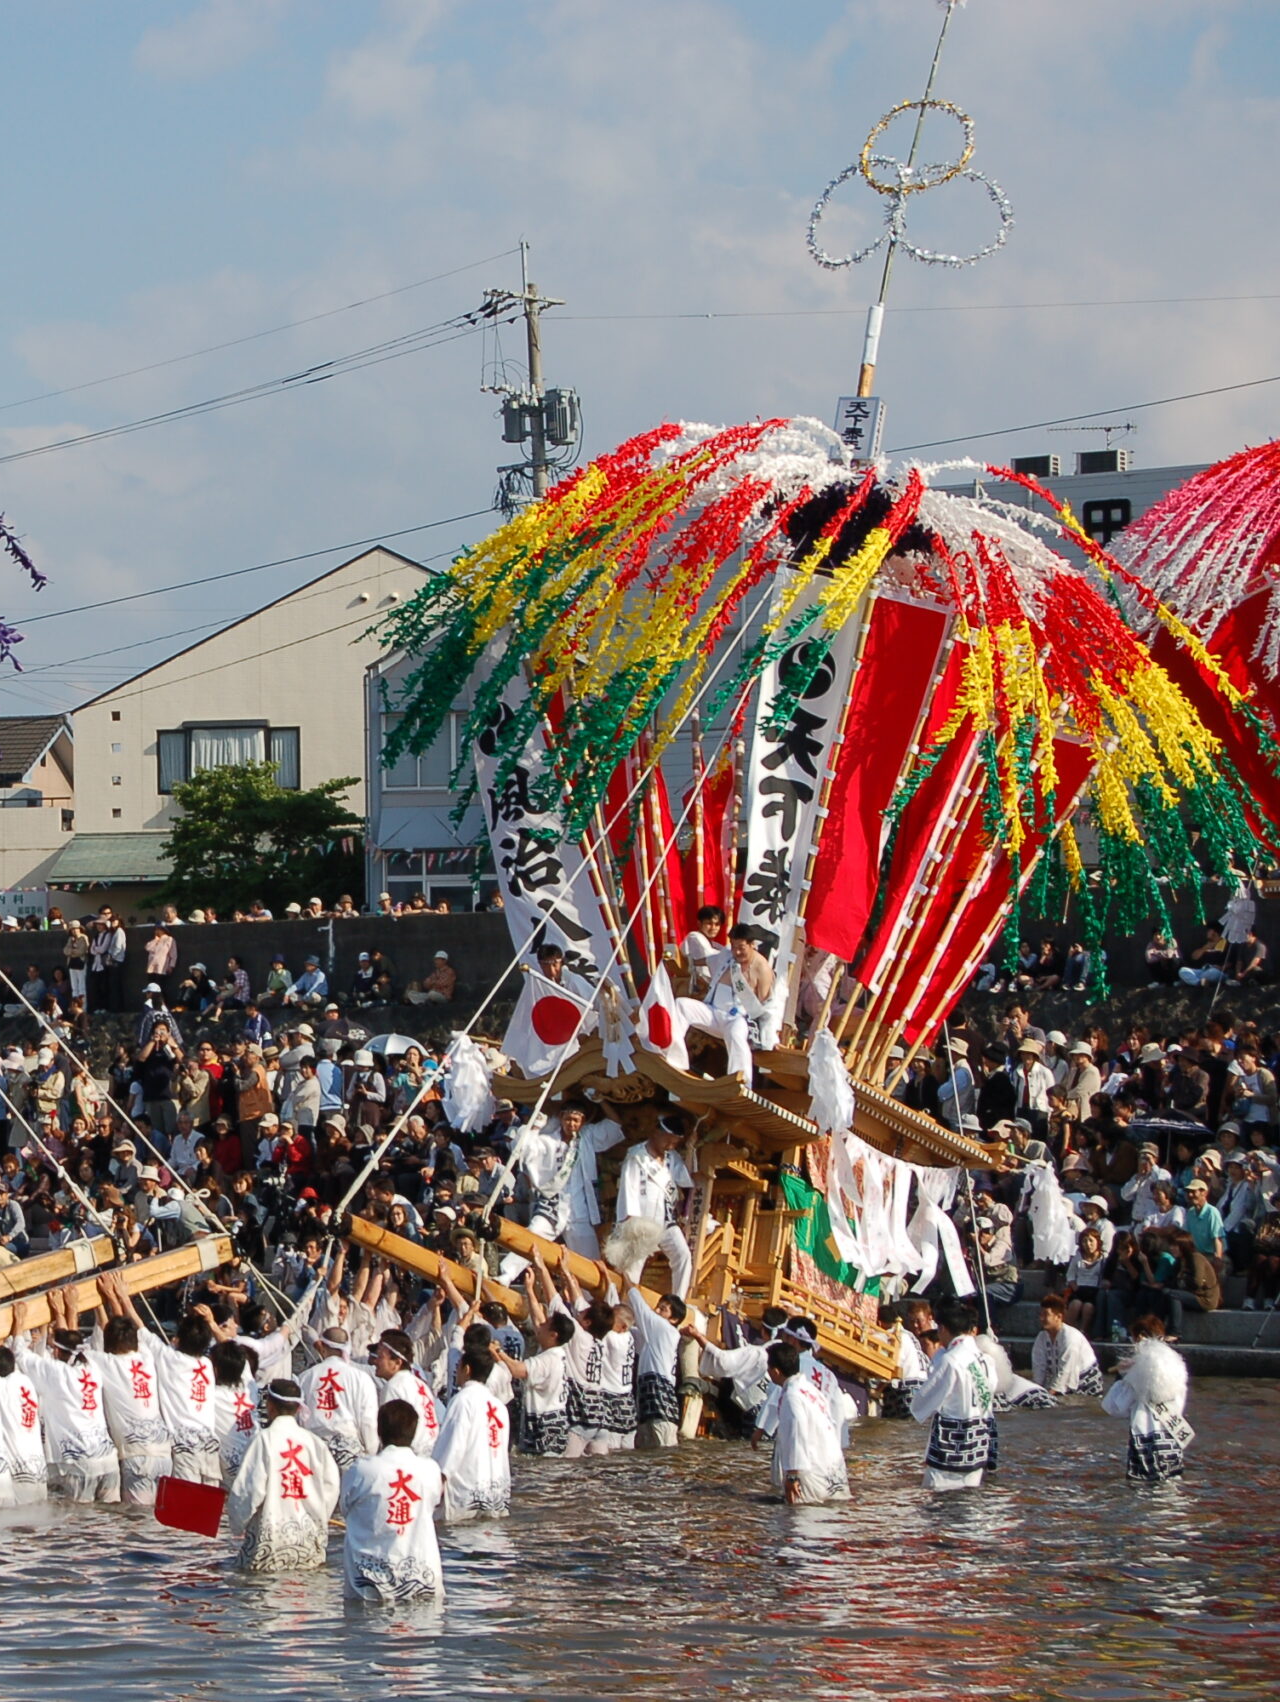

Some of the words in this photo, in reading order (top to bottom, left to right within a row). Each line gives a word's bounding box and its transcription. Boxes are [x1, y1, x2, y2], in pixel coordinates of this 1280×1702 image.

[487, 764, 600, 983] 風治八
[130, 1359, 152, 1408] 大通り
[189, 1360, 210, 1411] 大通り
[316, 1368, 345, 1419] 大通り
[232, 1392, 256, 1437] 大通り
[386, 1469, 422, 1535] 大通り
